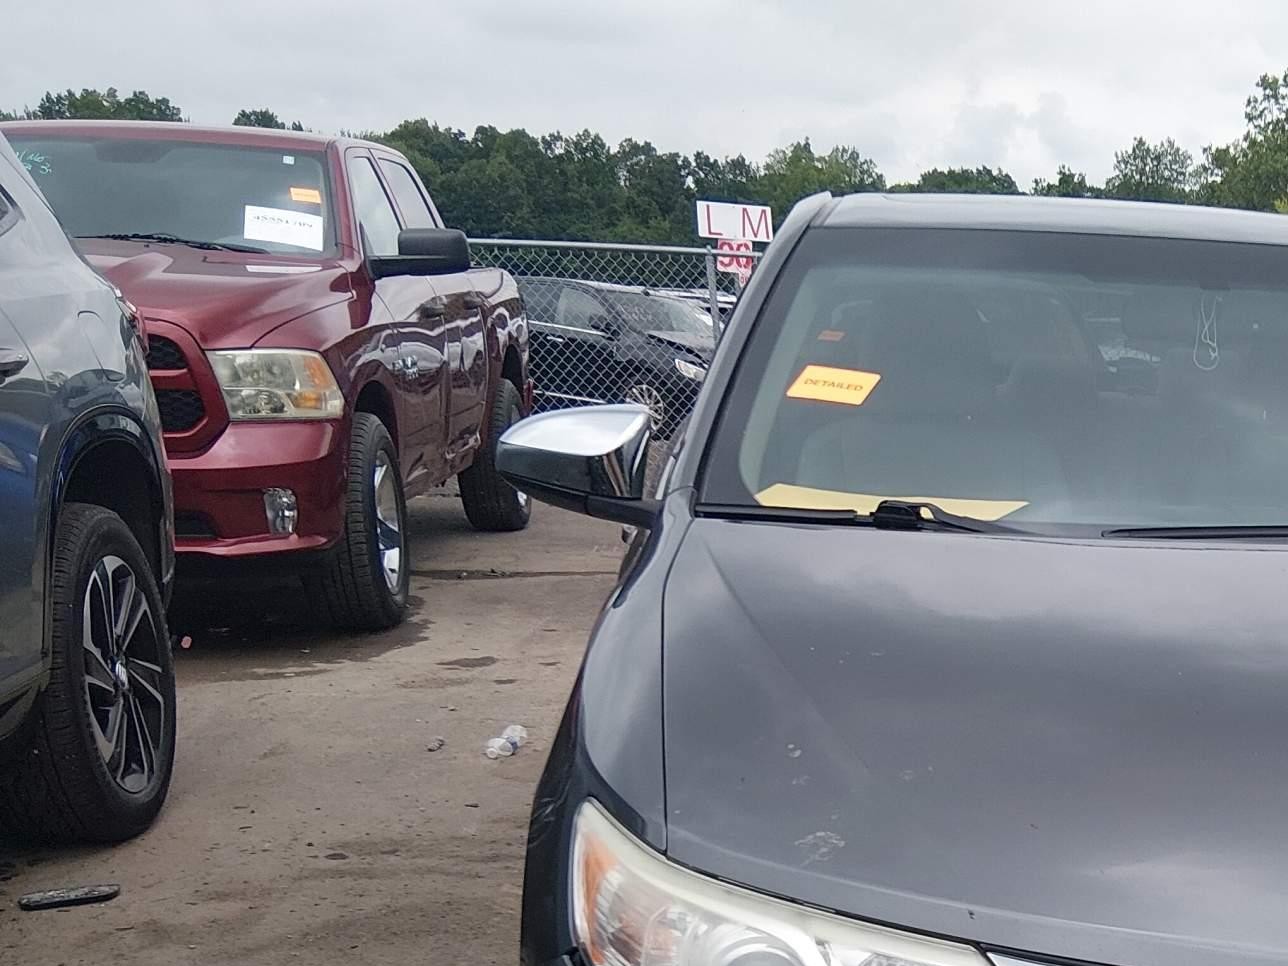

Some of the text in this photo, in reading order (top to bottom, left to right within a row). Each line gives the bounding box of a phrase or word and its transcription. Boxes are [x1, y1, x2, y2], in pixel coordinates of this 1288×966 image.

[705, 204, 770, 239] L M
[803, 377, 864, 392] DETAILED
